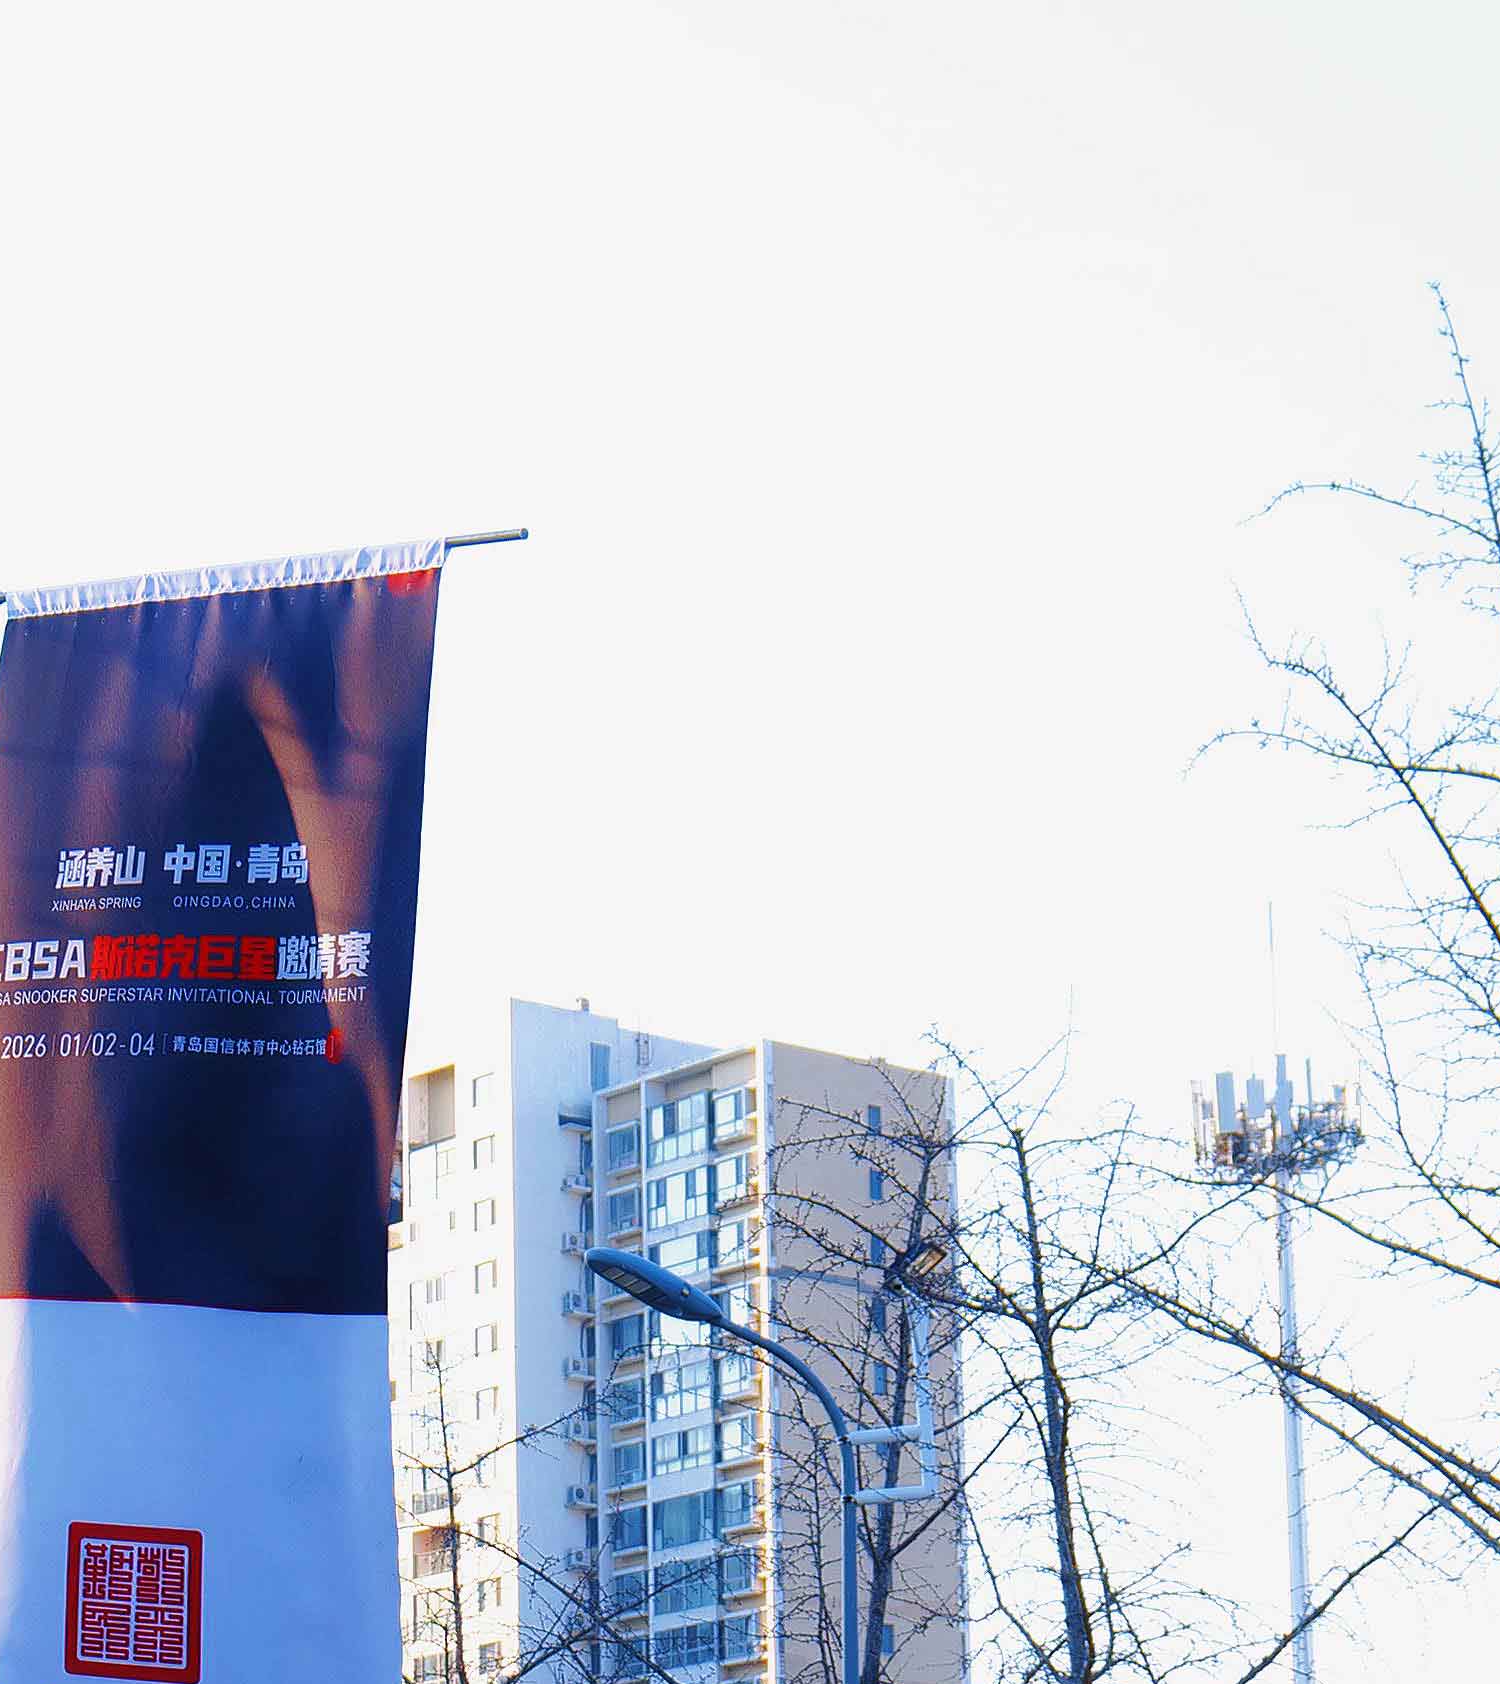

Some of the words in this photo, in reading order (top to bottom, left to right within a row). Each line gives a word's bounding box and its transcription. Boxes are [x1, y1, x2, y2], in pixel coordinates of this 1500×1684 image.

[55, 845, 146, 889] 涵养山
[163, 842, 309, 885] 中国·青岛
[98, 896, 142, 910] SPRING
[13, 988, 78, 1005] SNOOKER
[80, 986, 163, 1003] SUPERSTAR
[167, 987, 273, 1005] INVITATIONAL
[279, 986, 367, 1005] TOURNAMENT
[1, 1034, 47, 1060] 2026
